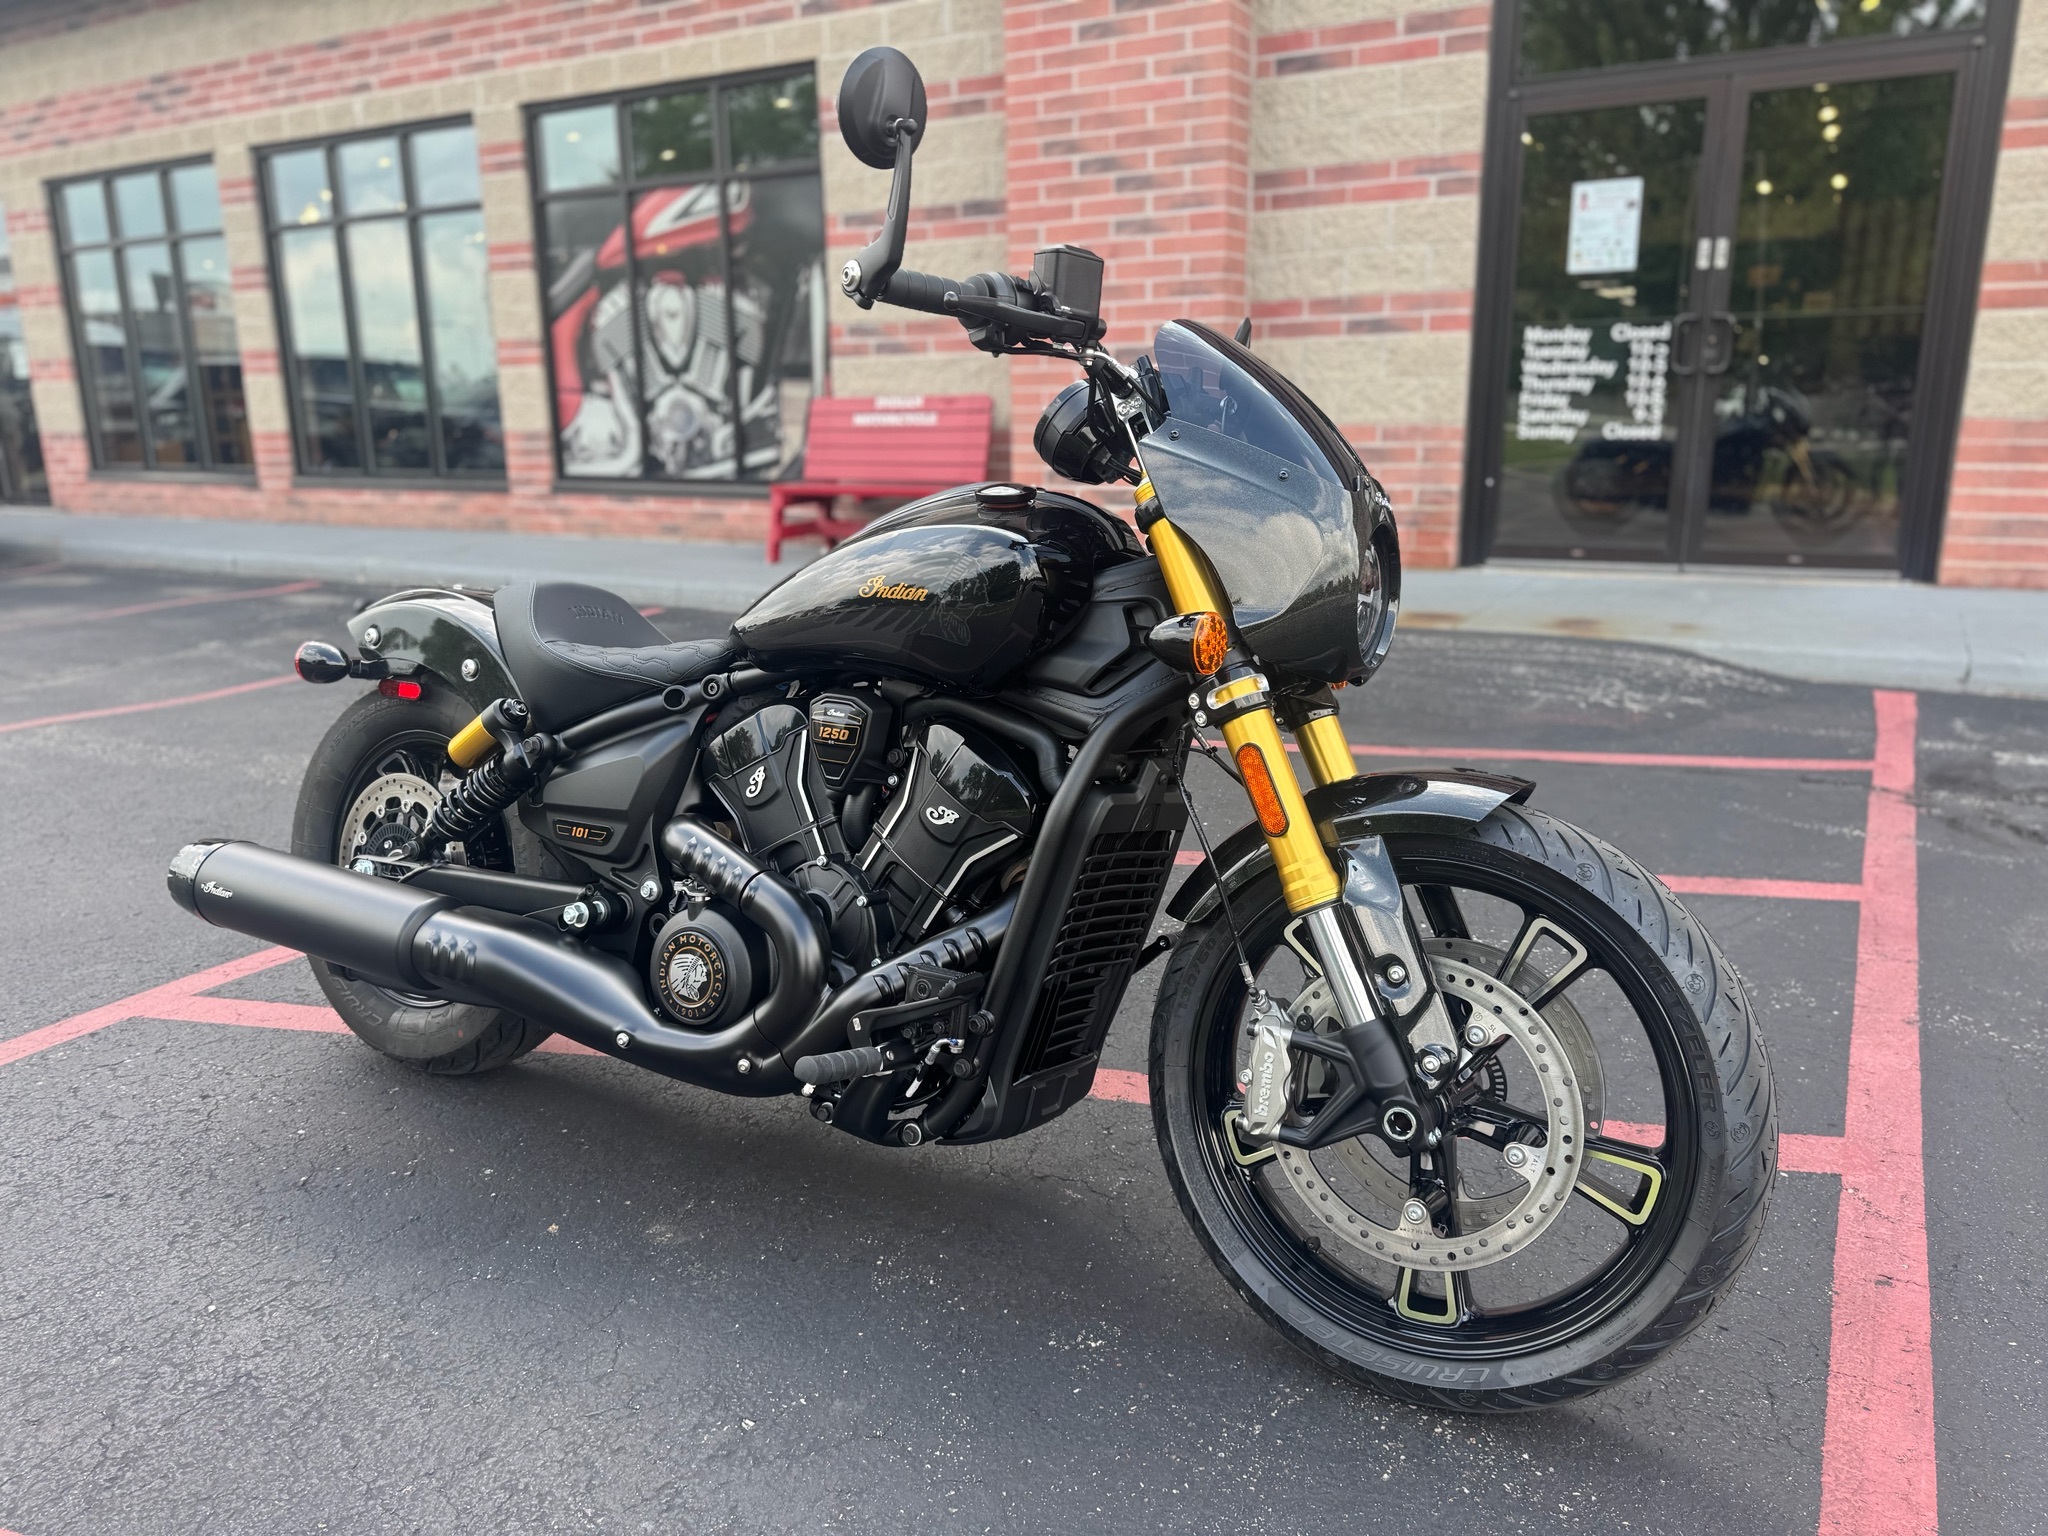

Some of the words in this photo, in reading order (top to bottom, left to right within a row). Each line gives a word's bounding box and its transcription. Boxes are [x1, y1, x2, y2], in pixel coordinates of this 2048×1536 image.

[1524, 324, 1592, 346] Monday
[1611, 322, 1671, 341] Closed
[1523, 342, 1590, 361] Tuesday
[1521, 359, 1617, 378] Wednesday
[1520, 375, 1595, 395] Thursday
[1519, 392, 1570, 410] Friday
[1518, 408, 1589, 427] Saturday
[1517, 424, 1577, 443] Sunday
[1602, 422, 1662, 440] Closed
[859, 575, 929, 602] Indian
[818, 726, 850, 741] 1250
[571, 826, 589, 839] 101
[201, 880, 234, 899] Indian
[659, 943, 677, 996] INDIAN
[679, 934, 723, 1008] MOTORCYCLE
[1253, 1050, 1275, 1117] brembo
[1285, 1303, 1492, 1385] CRUISETEC
